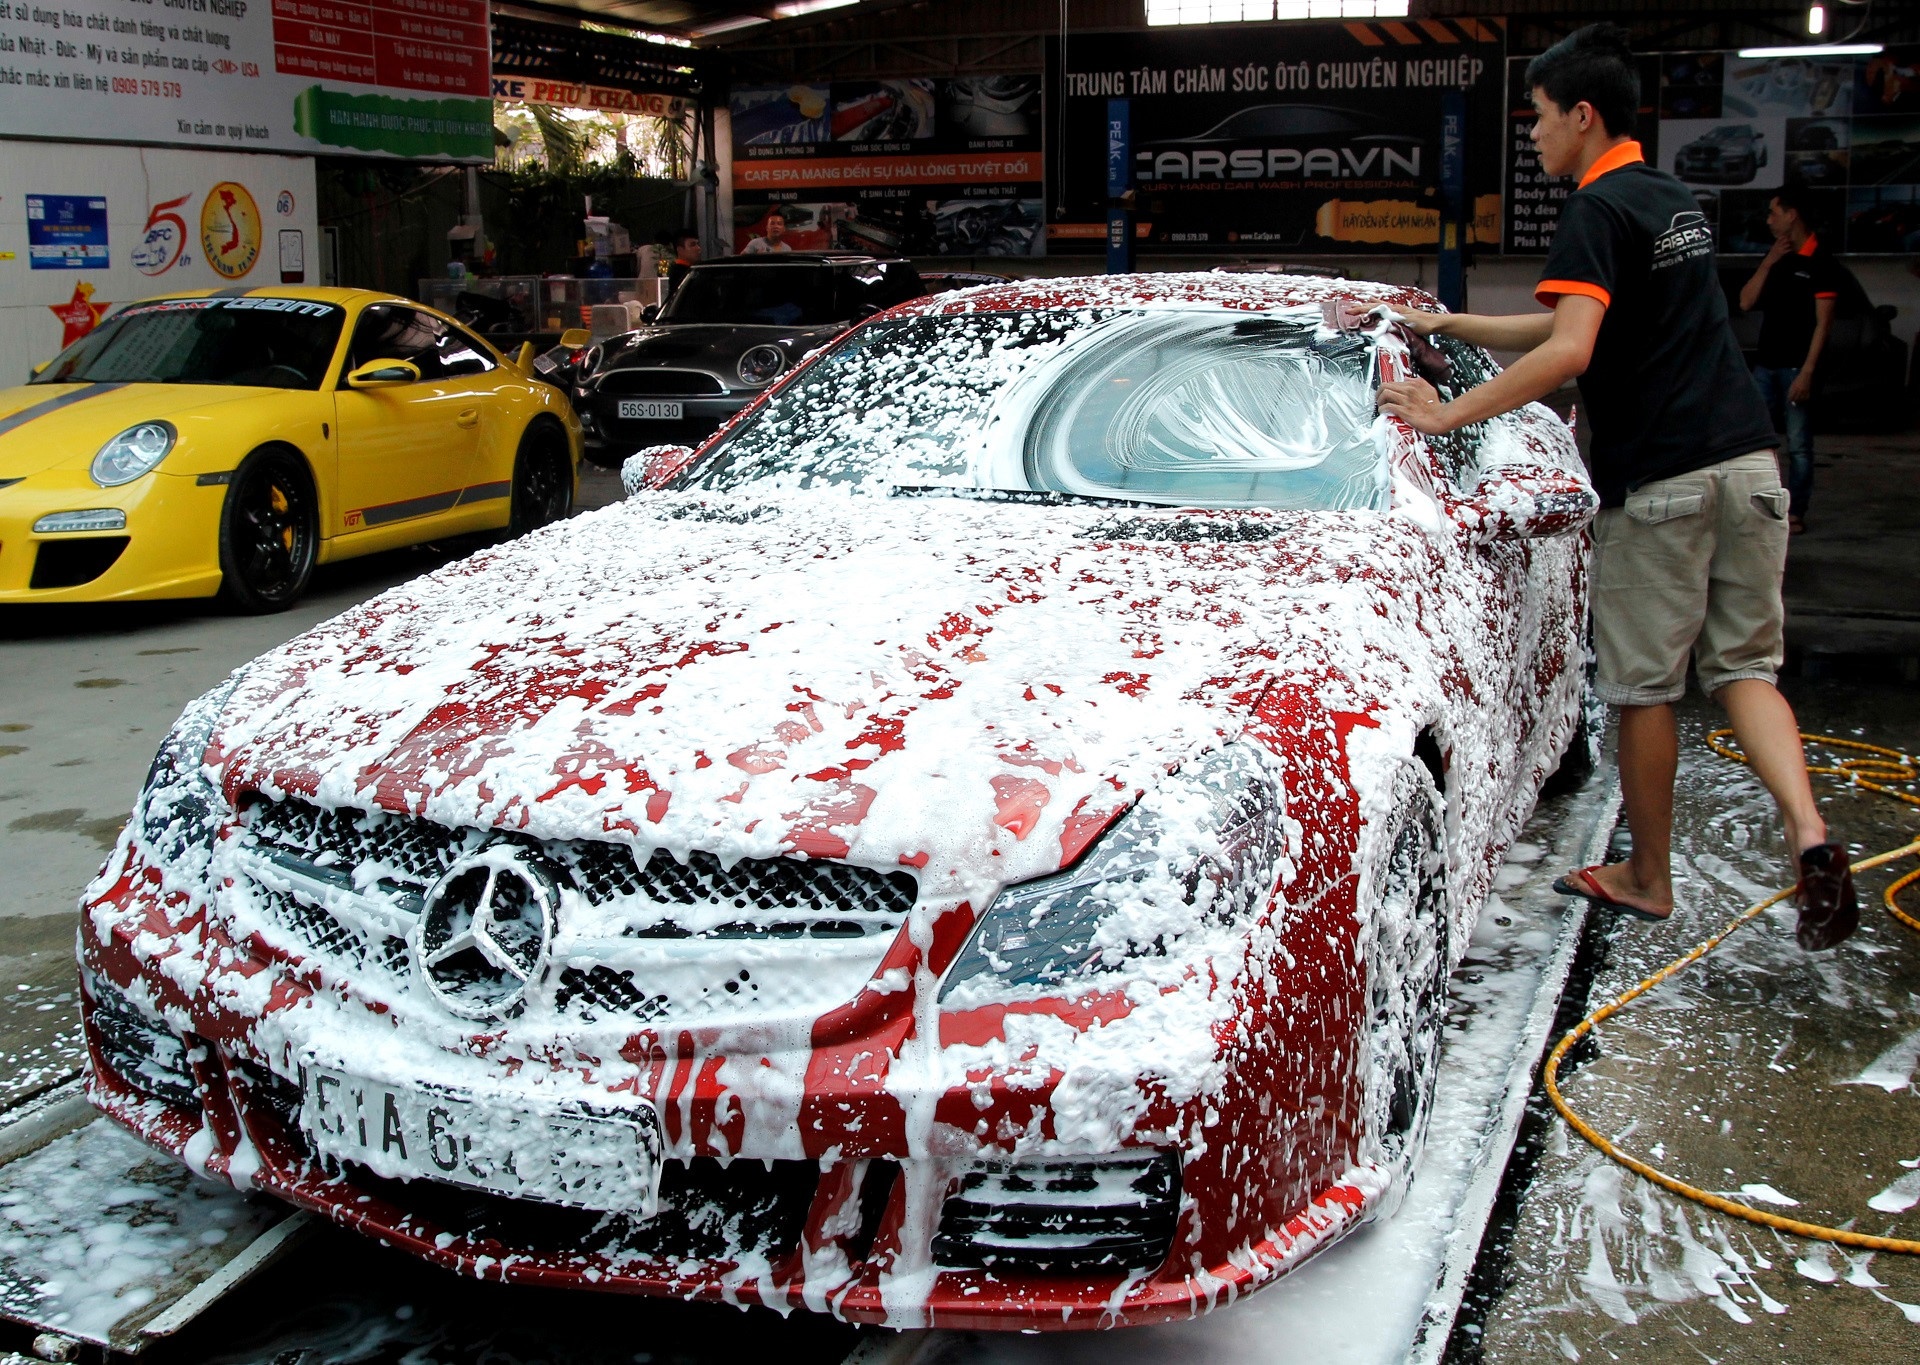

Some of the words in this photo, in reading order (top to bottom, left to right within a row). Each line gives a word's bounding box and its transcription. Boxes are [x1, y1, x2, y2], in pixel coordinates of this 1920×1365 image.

[241, 62, 260, 77] USA
[1066, 70, 1126, 97] TRUNG
[1130, 67, 1167, 94] TÂM
[1173, 64, 1226, 94] CHĂM
[1232, 62, 1269, 92] SÓC
[1275, 60, 1310, 91] ÔTÔ
[1317, 56, 1397, 89] CHUYÊN
[1405, 54, 1483, 91] NGHIỆP
[112, 76, 138, 94] 0909
[141, 79, 160, 96] 579
[163, 81, 182, 98] 579
[492, 80, 525, 98] XE
[588, 88, 664, 116] KHANG
[1110, 121, 1125, 160] PEAK
[744, 170, 770, 182] CAR
[772, 169, 800, 181] SPA
[802, 167, 840, 180] MANG
[843, 162, 870, 179] ĐẾN
[873, 165, 892, 180] SỰ
[895, 163, 917, 178] HÀI
[920, 161, 956, 178] LÒNG
[959, 160, 1001, 177] TUYỆT
[1004, 157, 1029, 175] ĐỐI
[1180, 180, 1221, 191] HAND
[1224, 180, 1254, 191] CAR
[1258, 180, 1301, 190] WASH
[1304, 179, 1418, 190] PROFESSIONAL
[1514, 188, 1546, 201] Body
